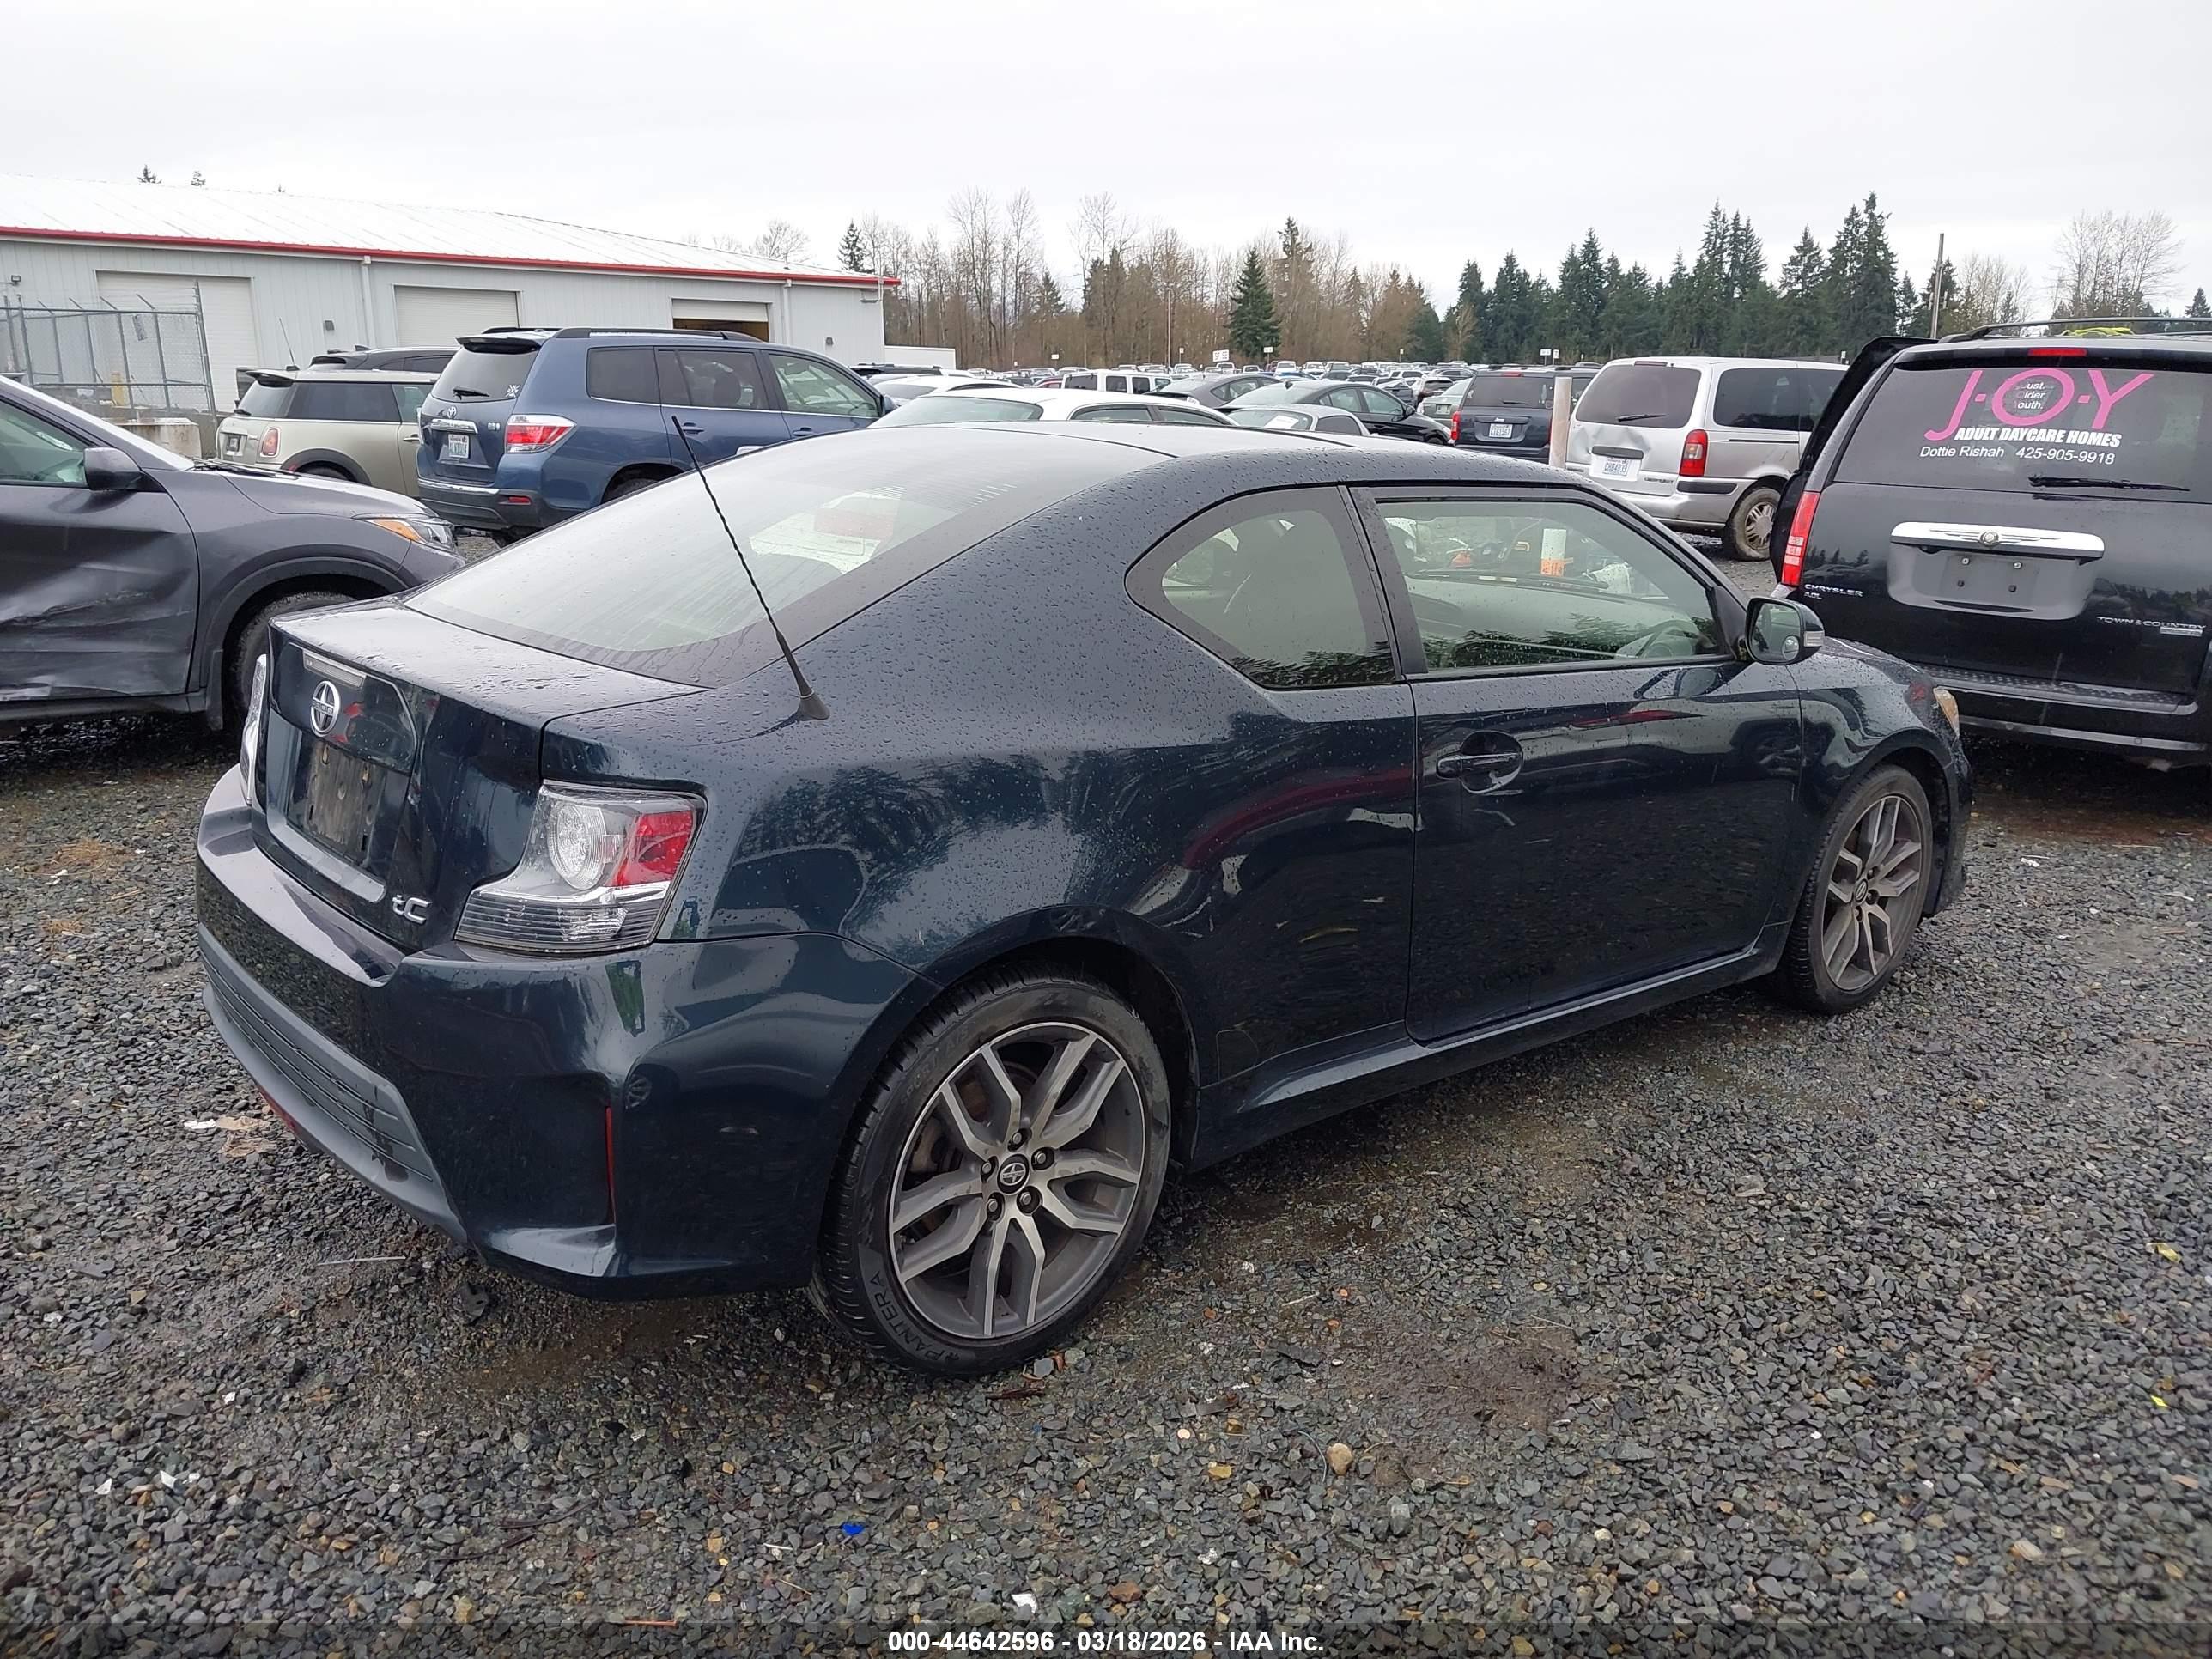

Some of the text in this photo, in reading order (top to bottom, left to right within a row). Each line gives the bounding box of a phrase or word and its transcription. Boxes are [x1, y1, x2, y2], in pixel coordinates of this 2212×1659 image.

[1954, 427, 2123, 448] ADULT DAYCARE HOMES
[1919, 446, 2116, 465] Dottie Rishah 425-905-9918
[1804, 584, 1863, 598] CHRYSLER
[870, 1271, 945, 1361] PANTERA
